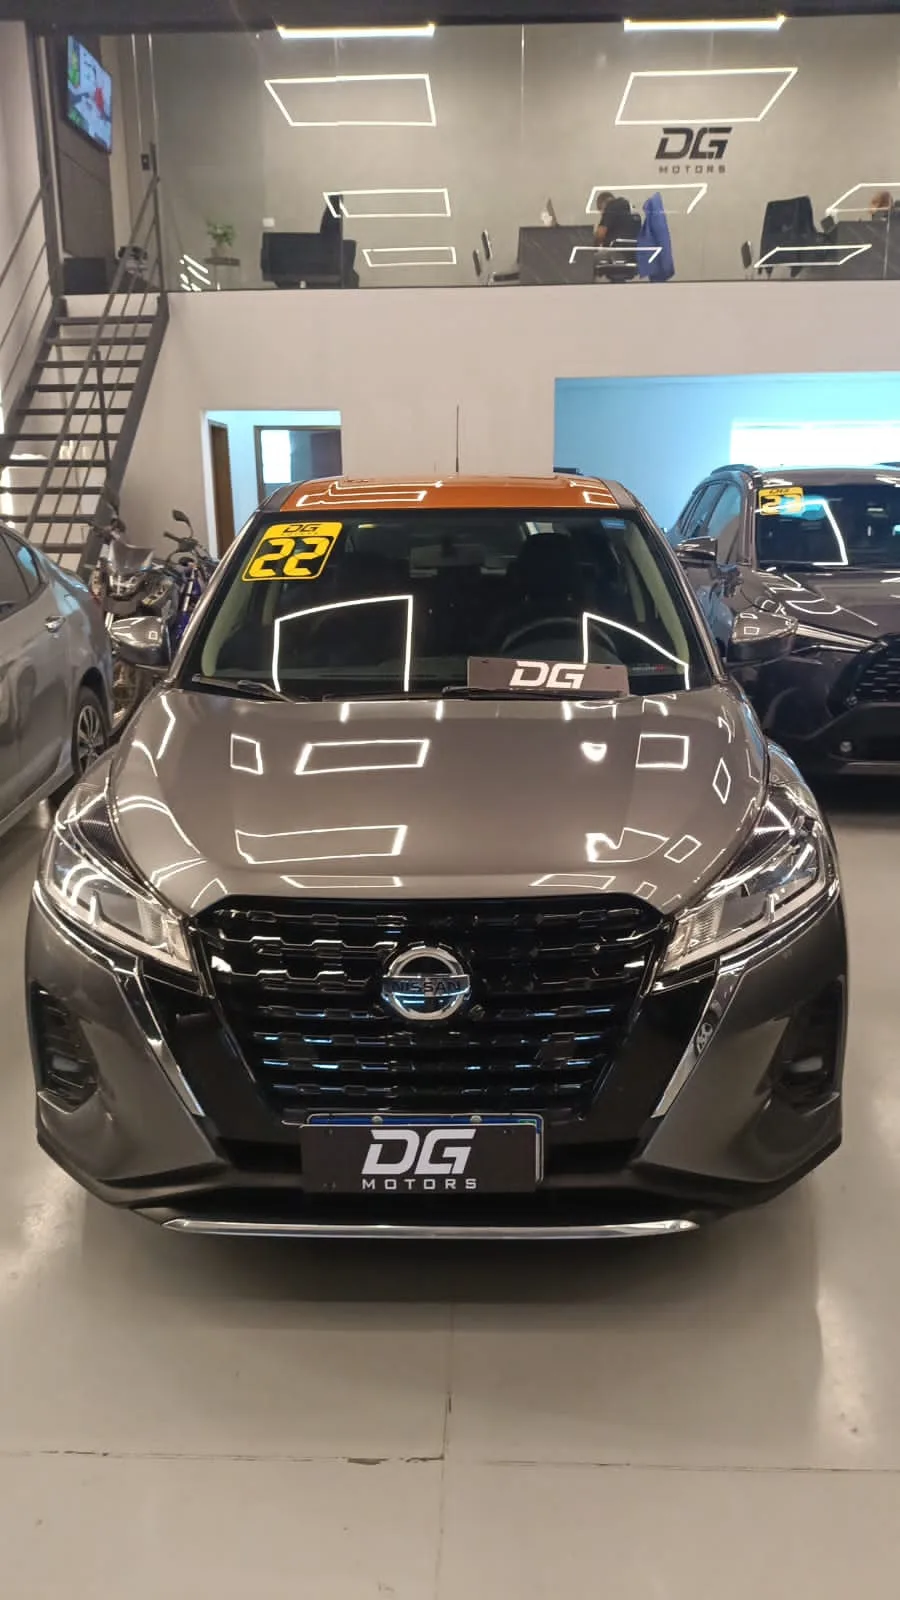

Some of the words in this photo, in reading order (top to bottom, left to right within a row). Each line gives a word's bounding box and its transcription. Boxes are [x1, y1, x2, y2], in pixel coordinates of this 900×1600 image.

[655, 127, 732, 159] DG
[658, 165, 726, 174] MOTORS
[249, 537, 330, 577] 22
[509, 660, 587, 689] DG
[391, 980, 458, 993] NISSAN
[361, 1128, 476, 1175] DG
[361, 1178, 477, 1190] MOTORS
